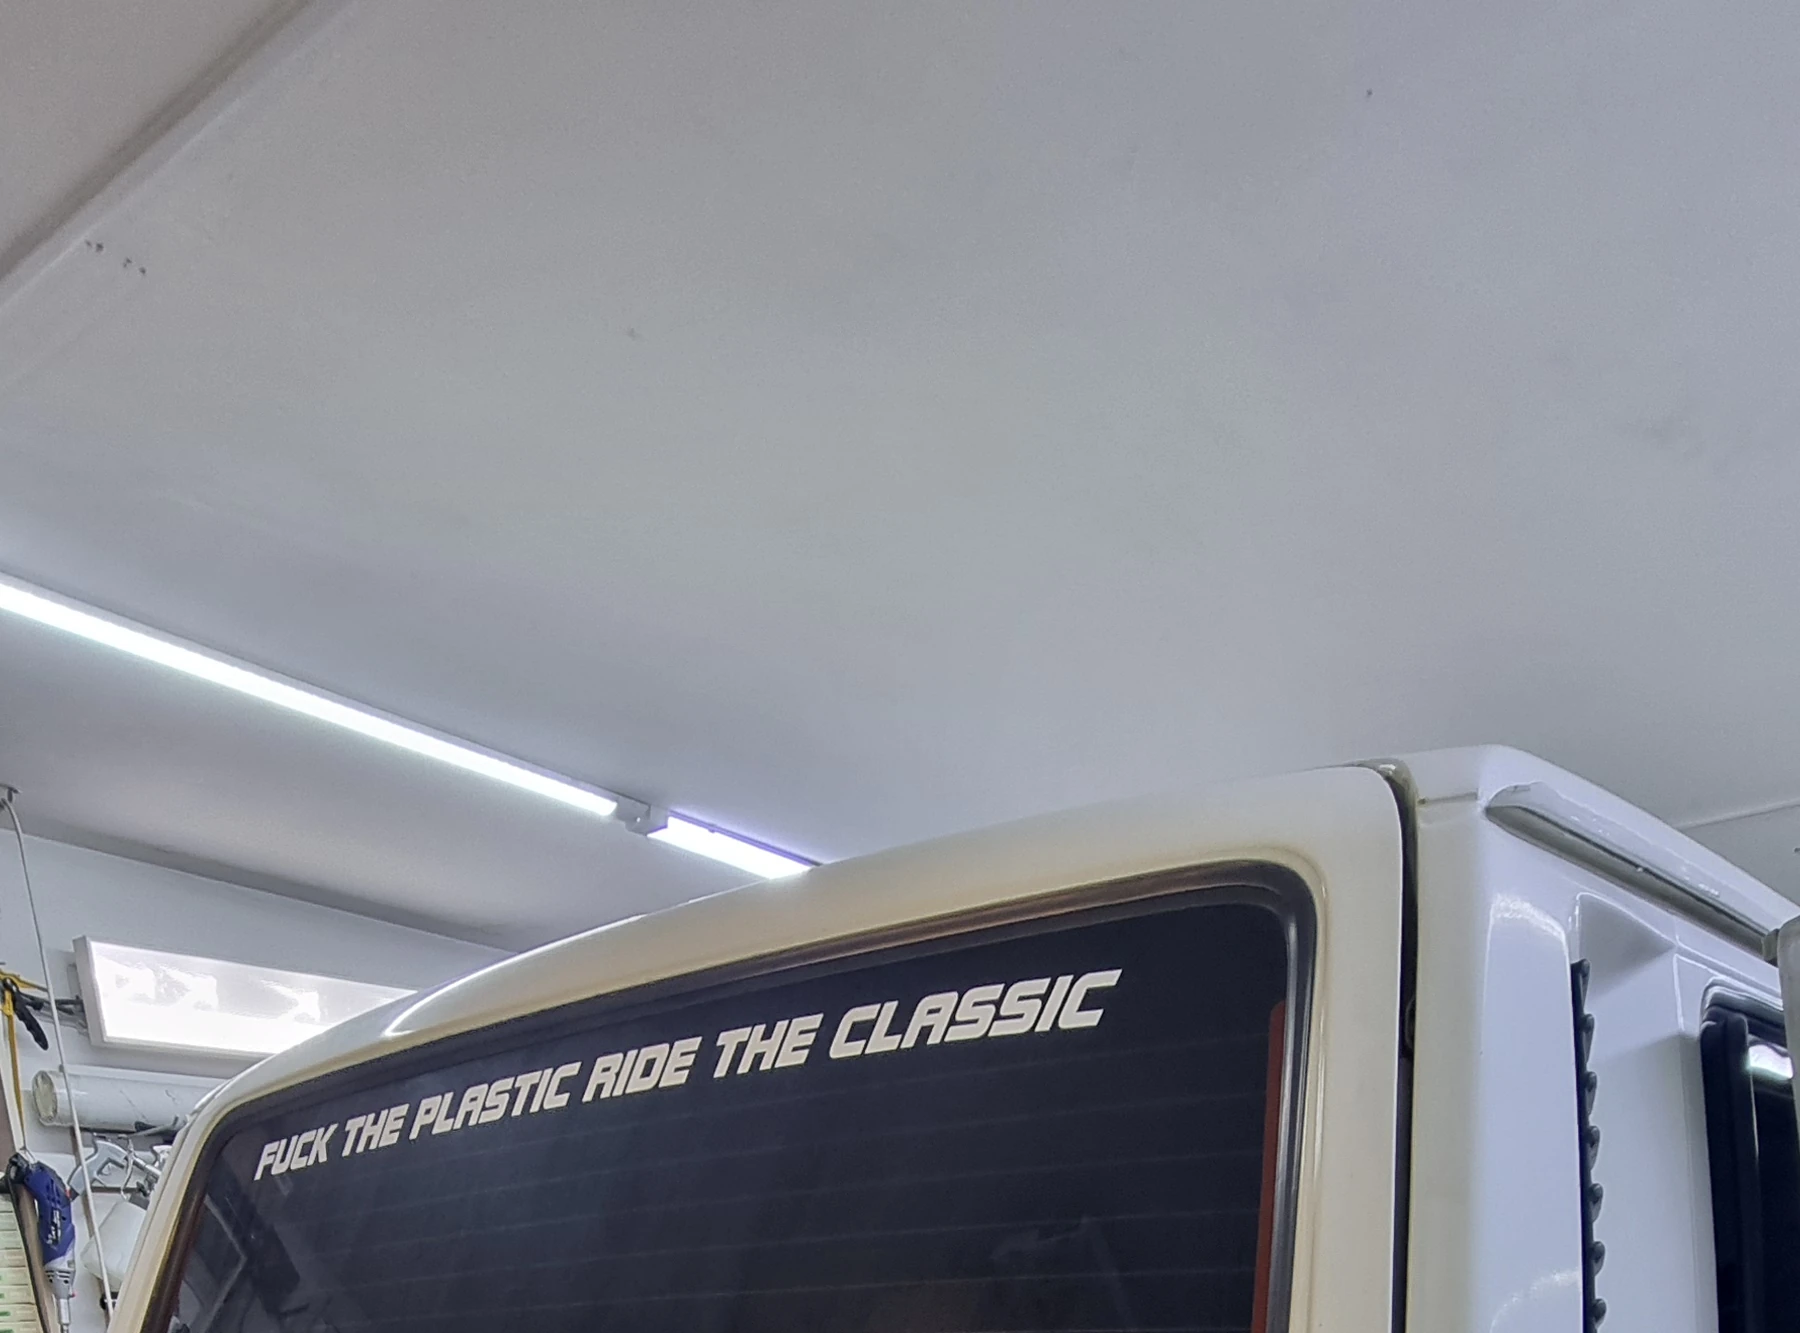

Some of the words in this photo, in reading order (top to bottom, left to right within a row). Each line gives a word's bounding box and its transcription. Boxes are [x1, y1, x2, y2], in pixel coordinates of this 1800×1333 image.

[254, 1123, 338, 1180] FUCK
[342, 1103, 410, 1157] THE
[409, 1061, 583, 1139] PLASTIC
[582, 1036, 702, 1102] RIDE
[713, 1013, 824, 1078] THE
[829, 969, 1123, 1059] CLASSIC
